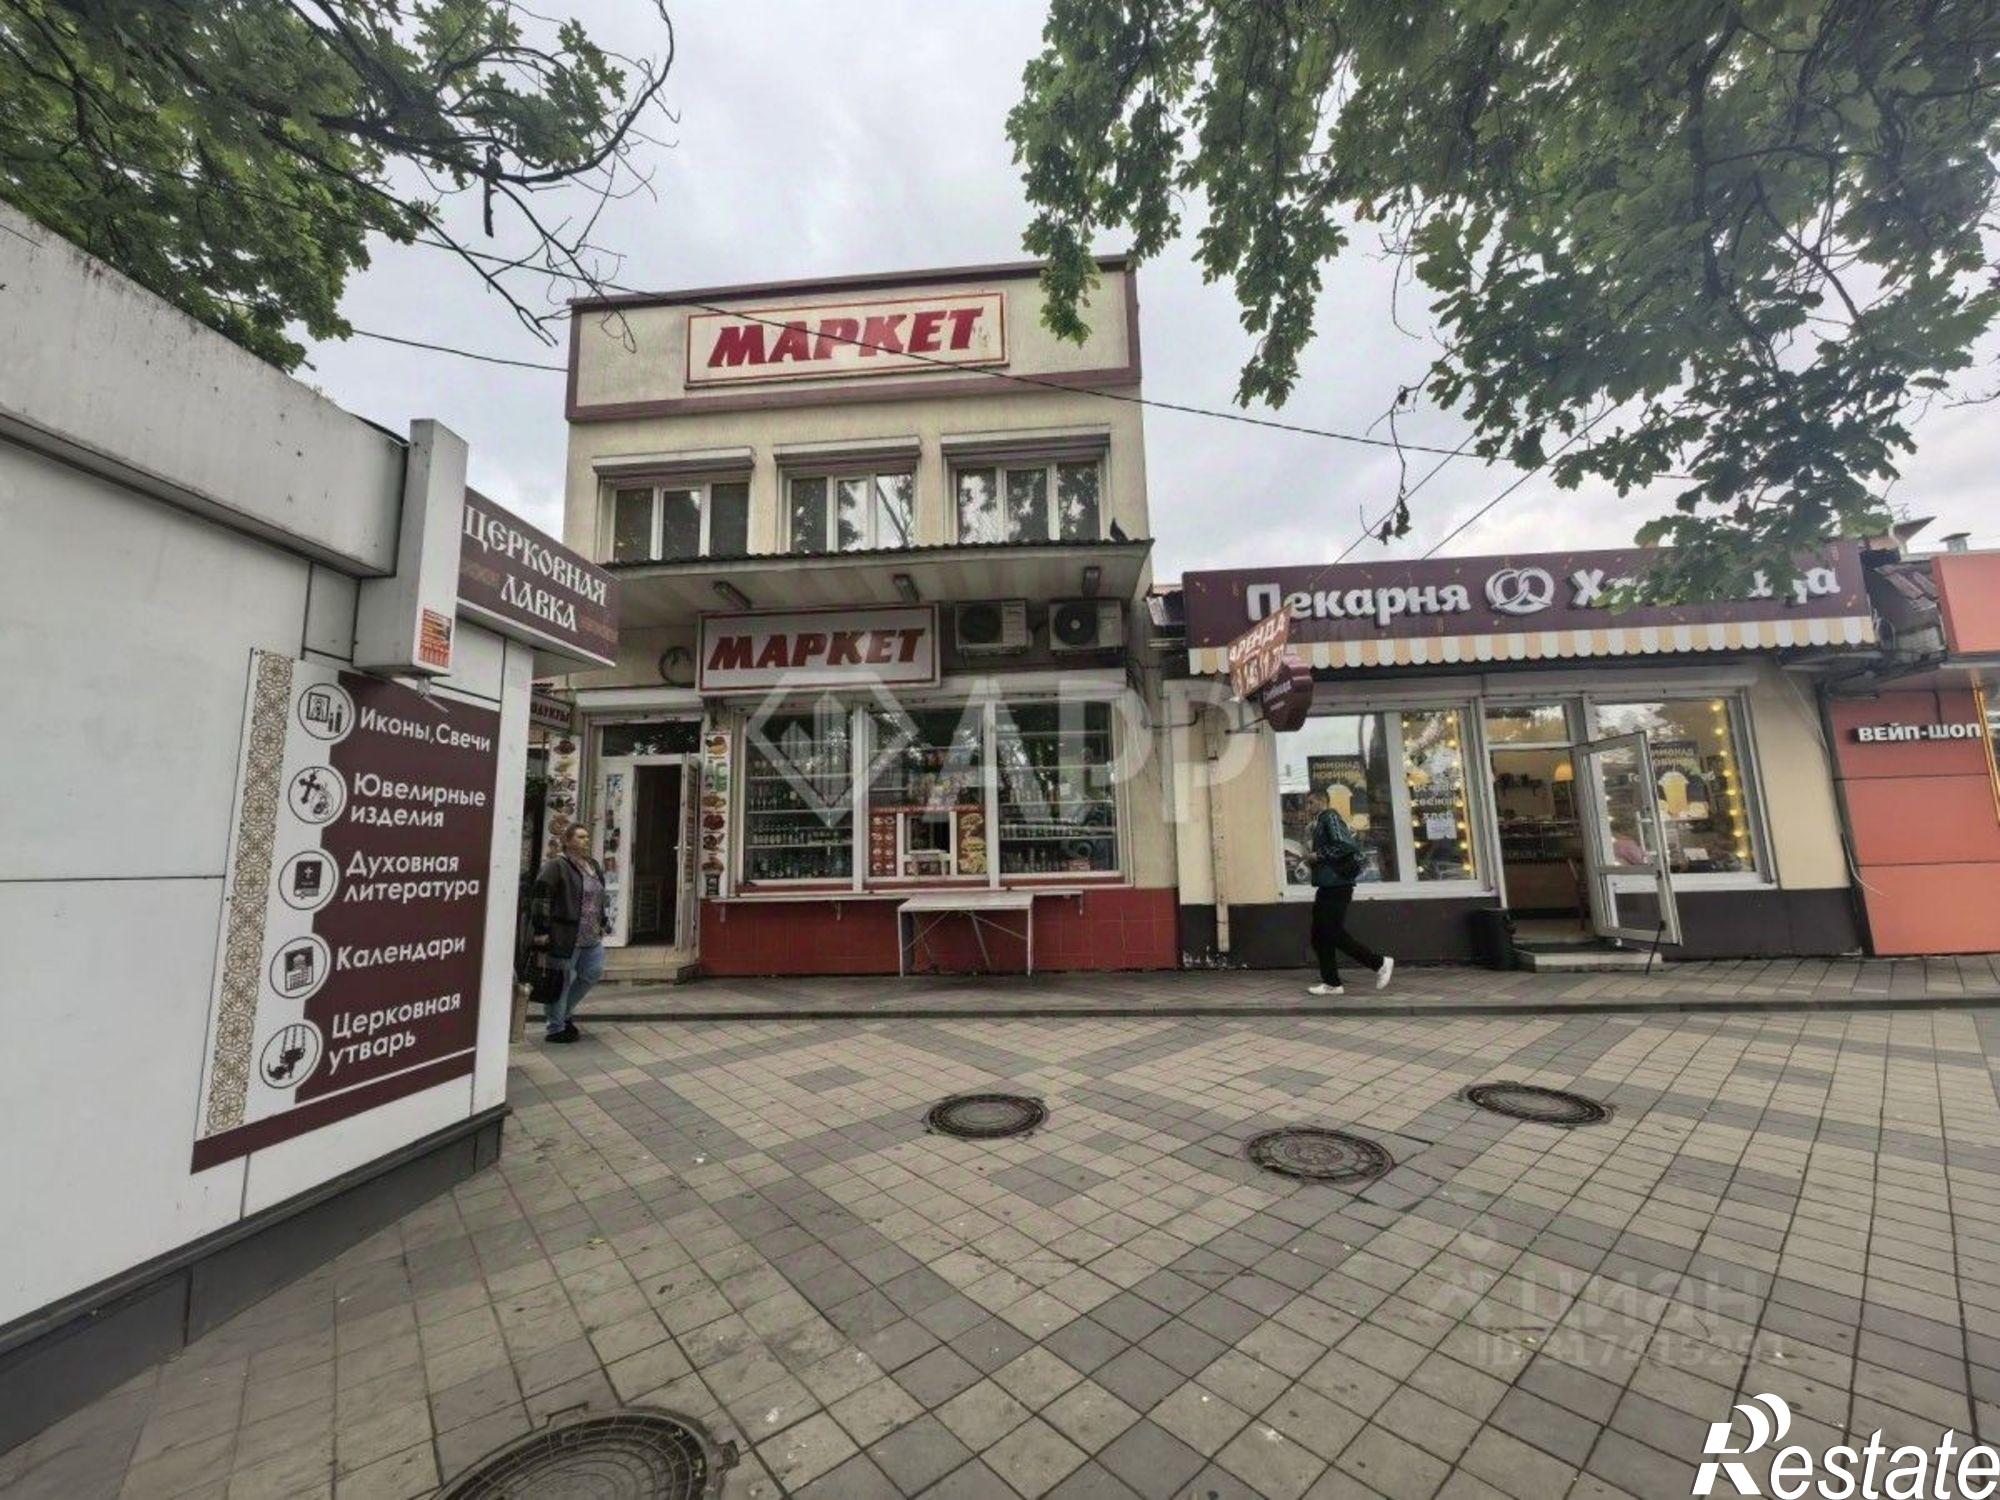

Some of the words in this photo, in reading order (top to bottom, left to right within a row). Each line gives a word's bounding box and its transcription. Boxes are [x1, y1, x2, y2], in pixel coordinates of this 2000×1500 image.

[707, 307, 984, 368] МАРКЕТ
[463, 504, 607, 607] ЦЕРКОВНАЯ
[501, 574, 577, 632] ЛАВКА
[1246, 583, 1472, 627] Пекарня
[707, 628, 925, 670] МАРКЕТ
[1857, 723, 1982, 742] ВЕЙП-ШОП
[354, 772, 486, 808] Ювелирные
[350, 804, 445, 829] изделия
[345, 851, 459, 877] Духовная
[343, 876, 480, 904] литература
[336, 935, 466, 971] Календари
[332, 993, 461, 1040] Церковная
[328, 1030, 416, 1076] утварь
